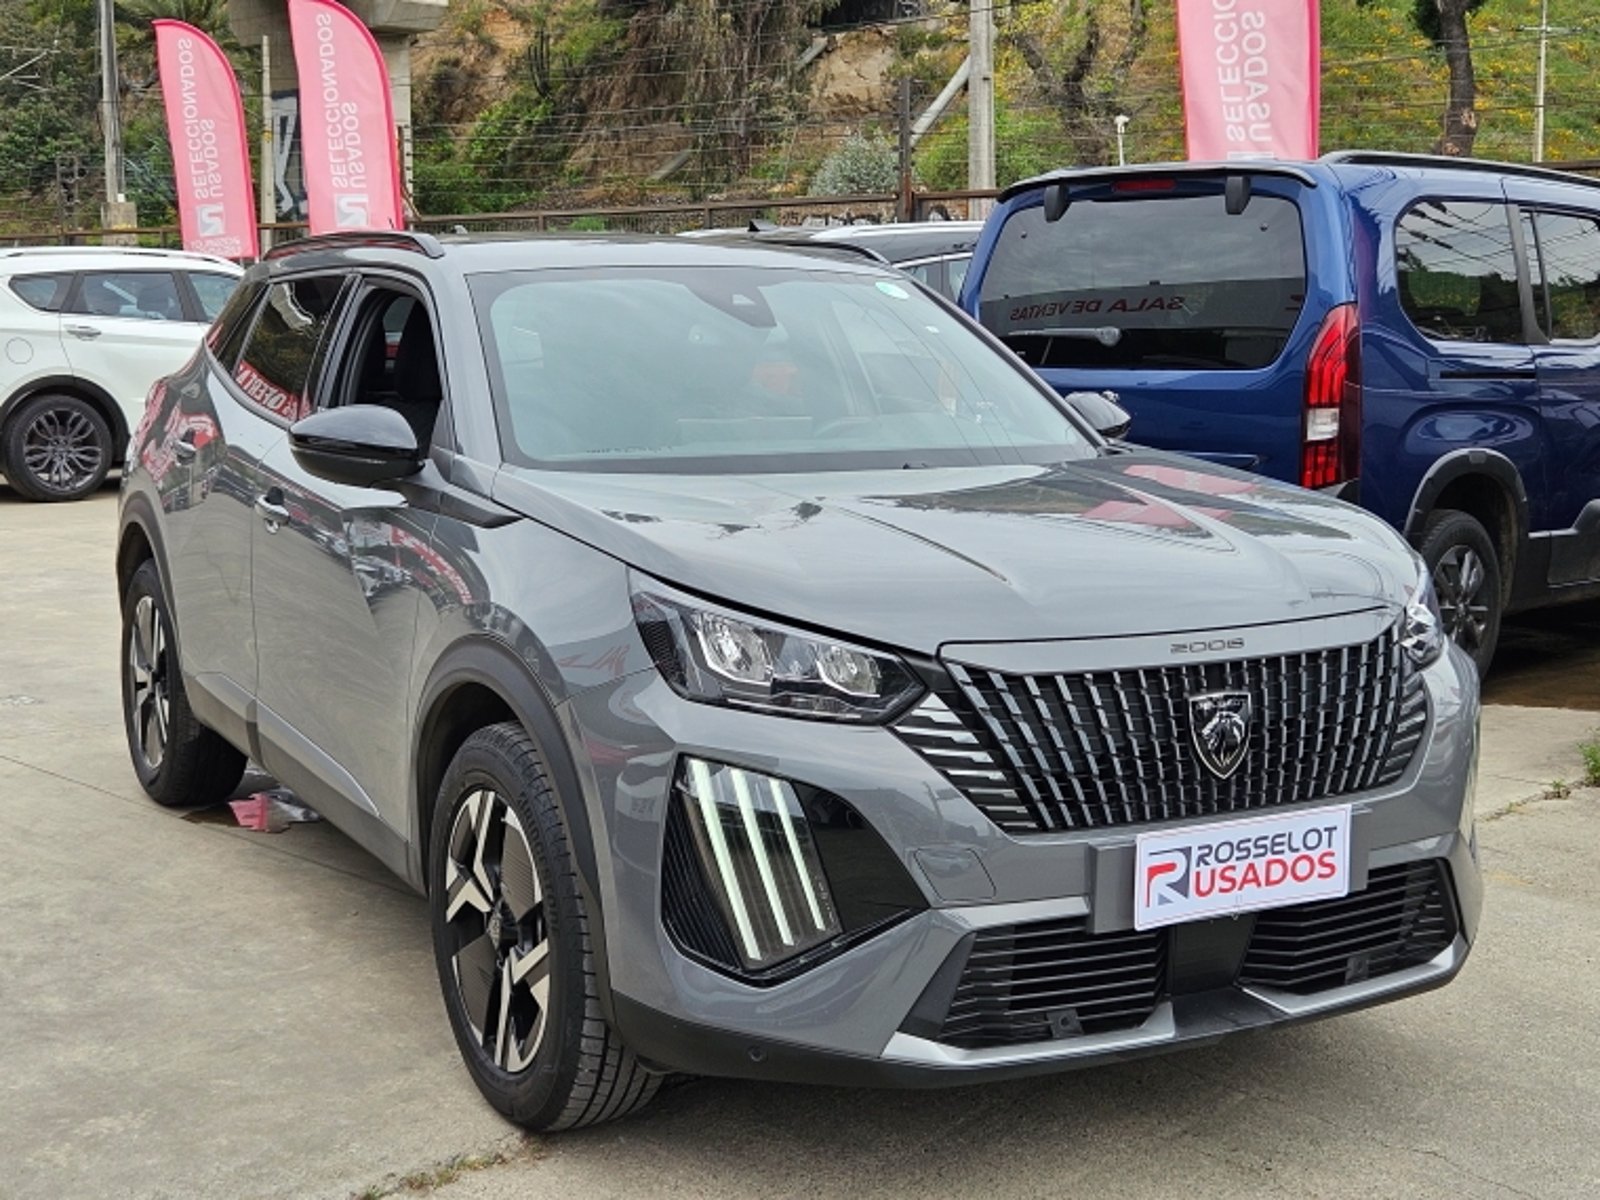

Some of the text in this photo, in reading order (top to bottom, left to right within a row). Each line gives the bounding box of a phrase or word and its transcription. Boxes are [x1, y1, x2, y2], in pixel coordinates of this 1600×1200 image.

[1170, 638, 1245, 654] 2008
[1196, 825, 1338, 868] ROSSELOT
[1194, 851, 1336, 897] USADOS
